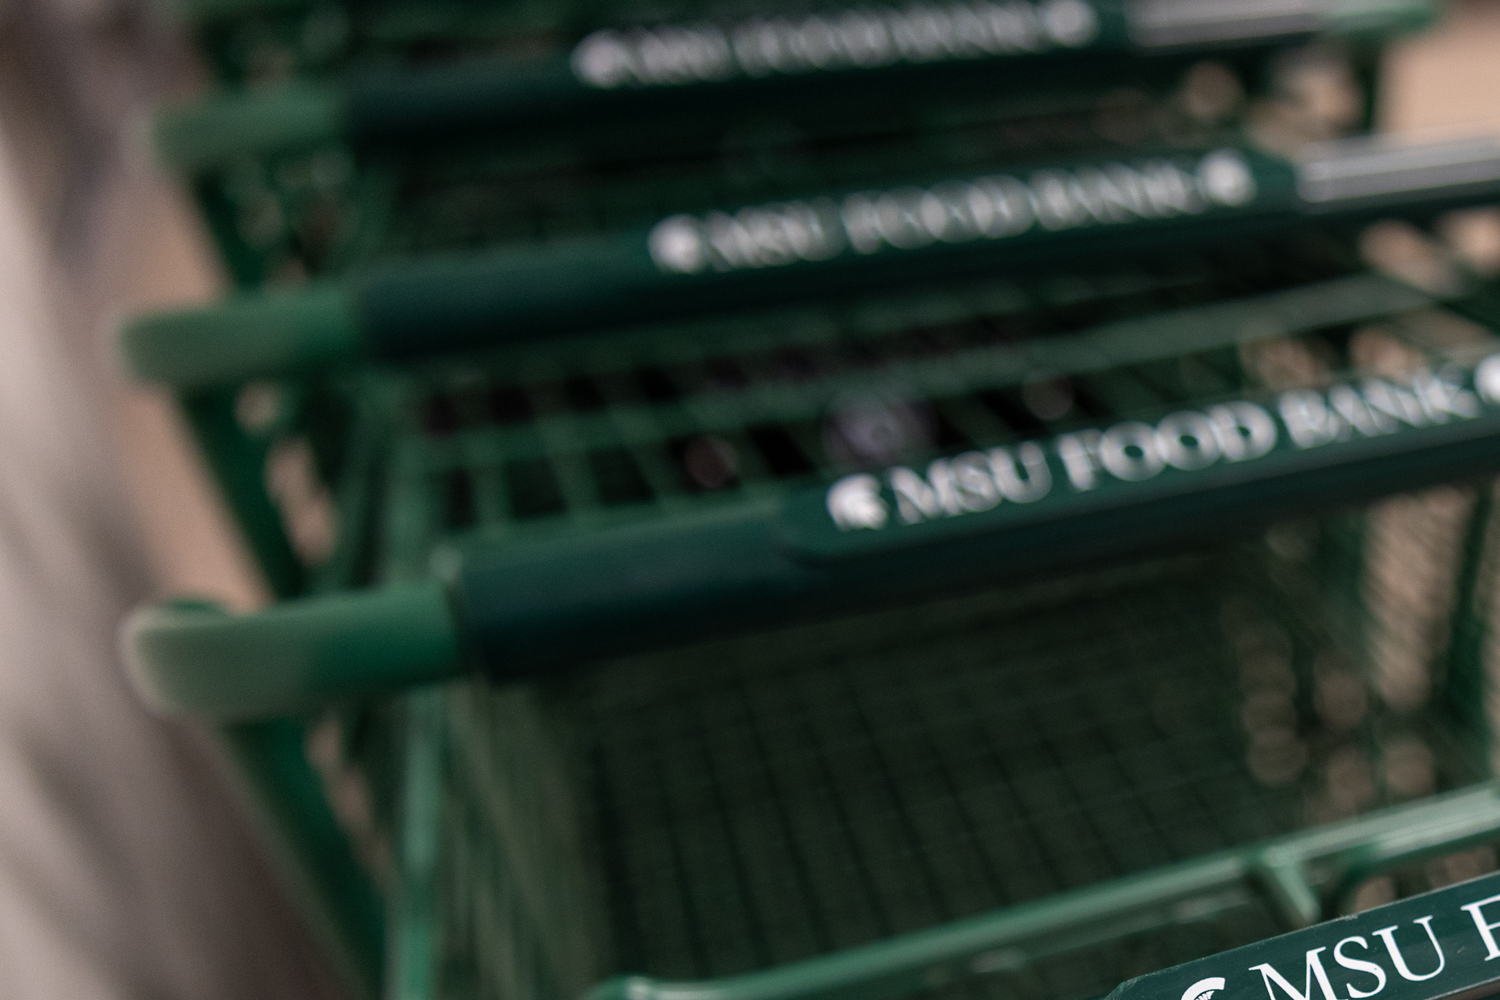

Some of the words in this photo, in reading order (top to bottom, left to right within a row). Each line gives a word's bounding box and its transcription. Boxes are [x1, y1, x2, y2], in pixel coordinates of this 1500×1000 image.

[890, 442, 1053, 525] MSU
[1057, 402, 1277, 490] FOOD
[1278, 365, 1480, 449] BANK
